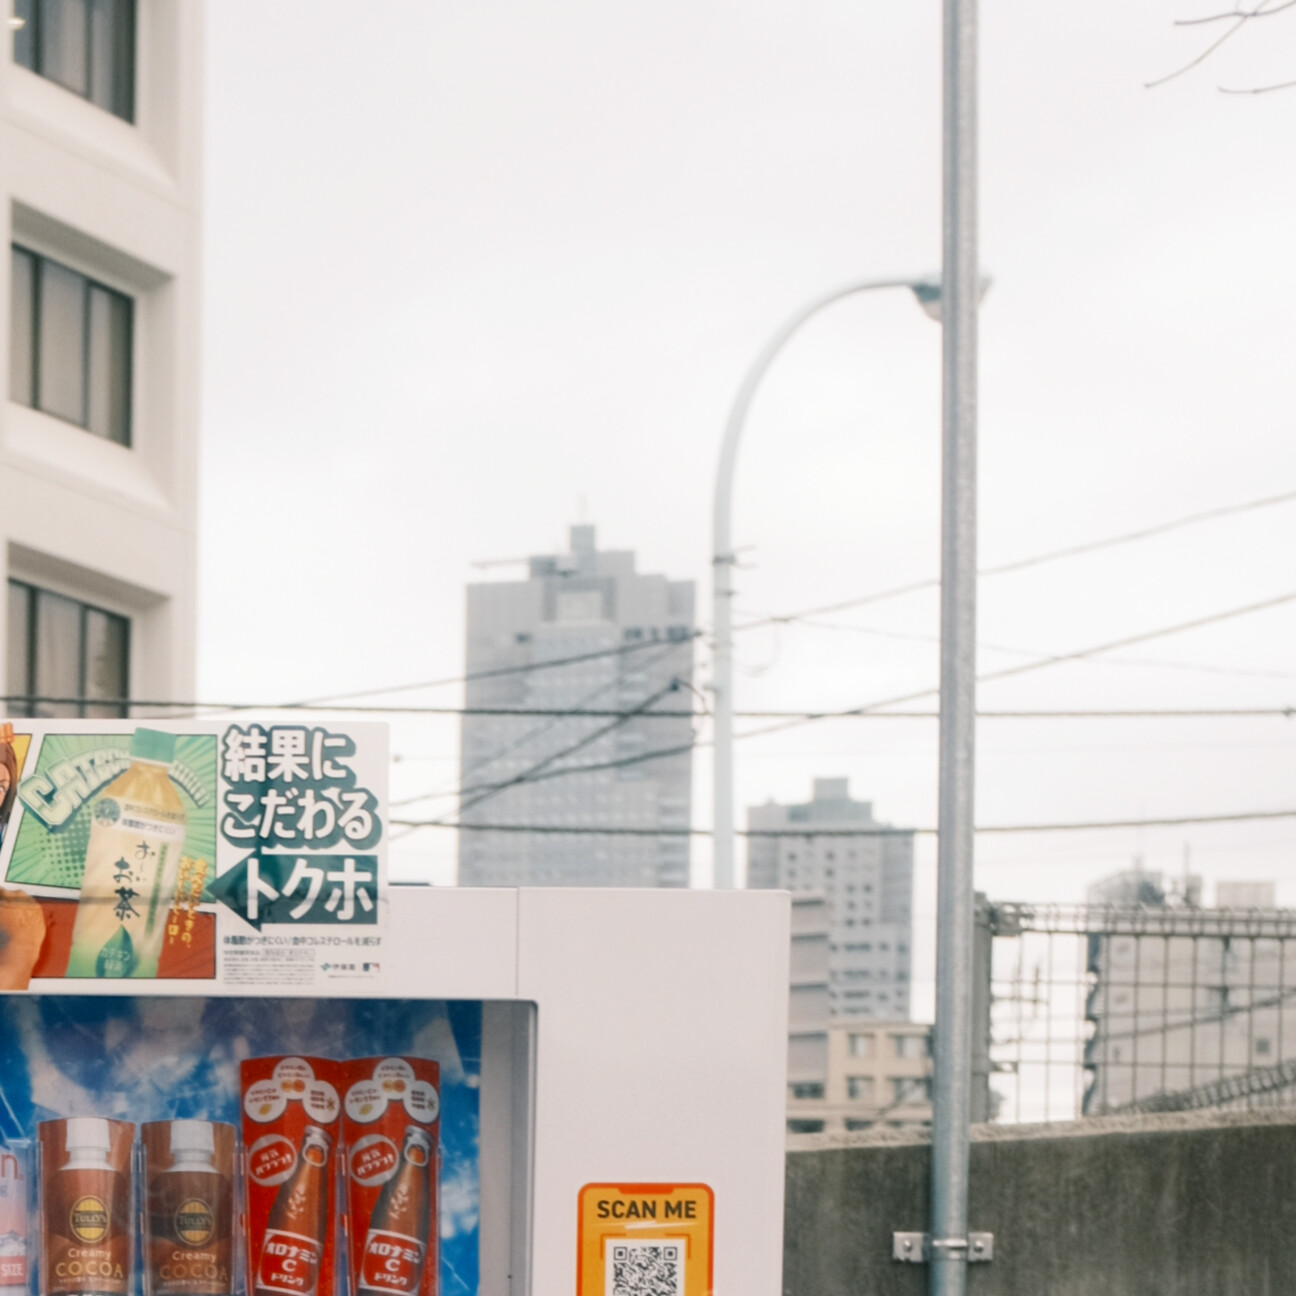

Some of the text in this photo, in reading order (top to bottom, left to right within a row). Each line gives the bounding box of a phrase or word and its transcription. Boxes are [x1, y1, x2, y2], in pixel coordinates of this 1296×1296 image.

[226, 727, 348, 783] 結果に
[225, 789, 375, 841] こだわる
[246, 857, 373, 922] トクホ
[597, 1200, 696, 1218] SCAN ME
[68, 1248, 111, 1260] Creamy
[172, 1251, 217, 1263] Creamy
[0, 1263, 24, 1277] SIZE
[55, 1262, 124, 1278] COCOA
[159, 1265, 228, 1281] COCOA
[282, 1260, 296, 1272] C
[385, 1260, 399, 1272] C
